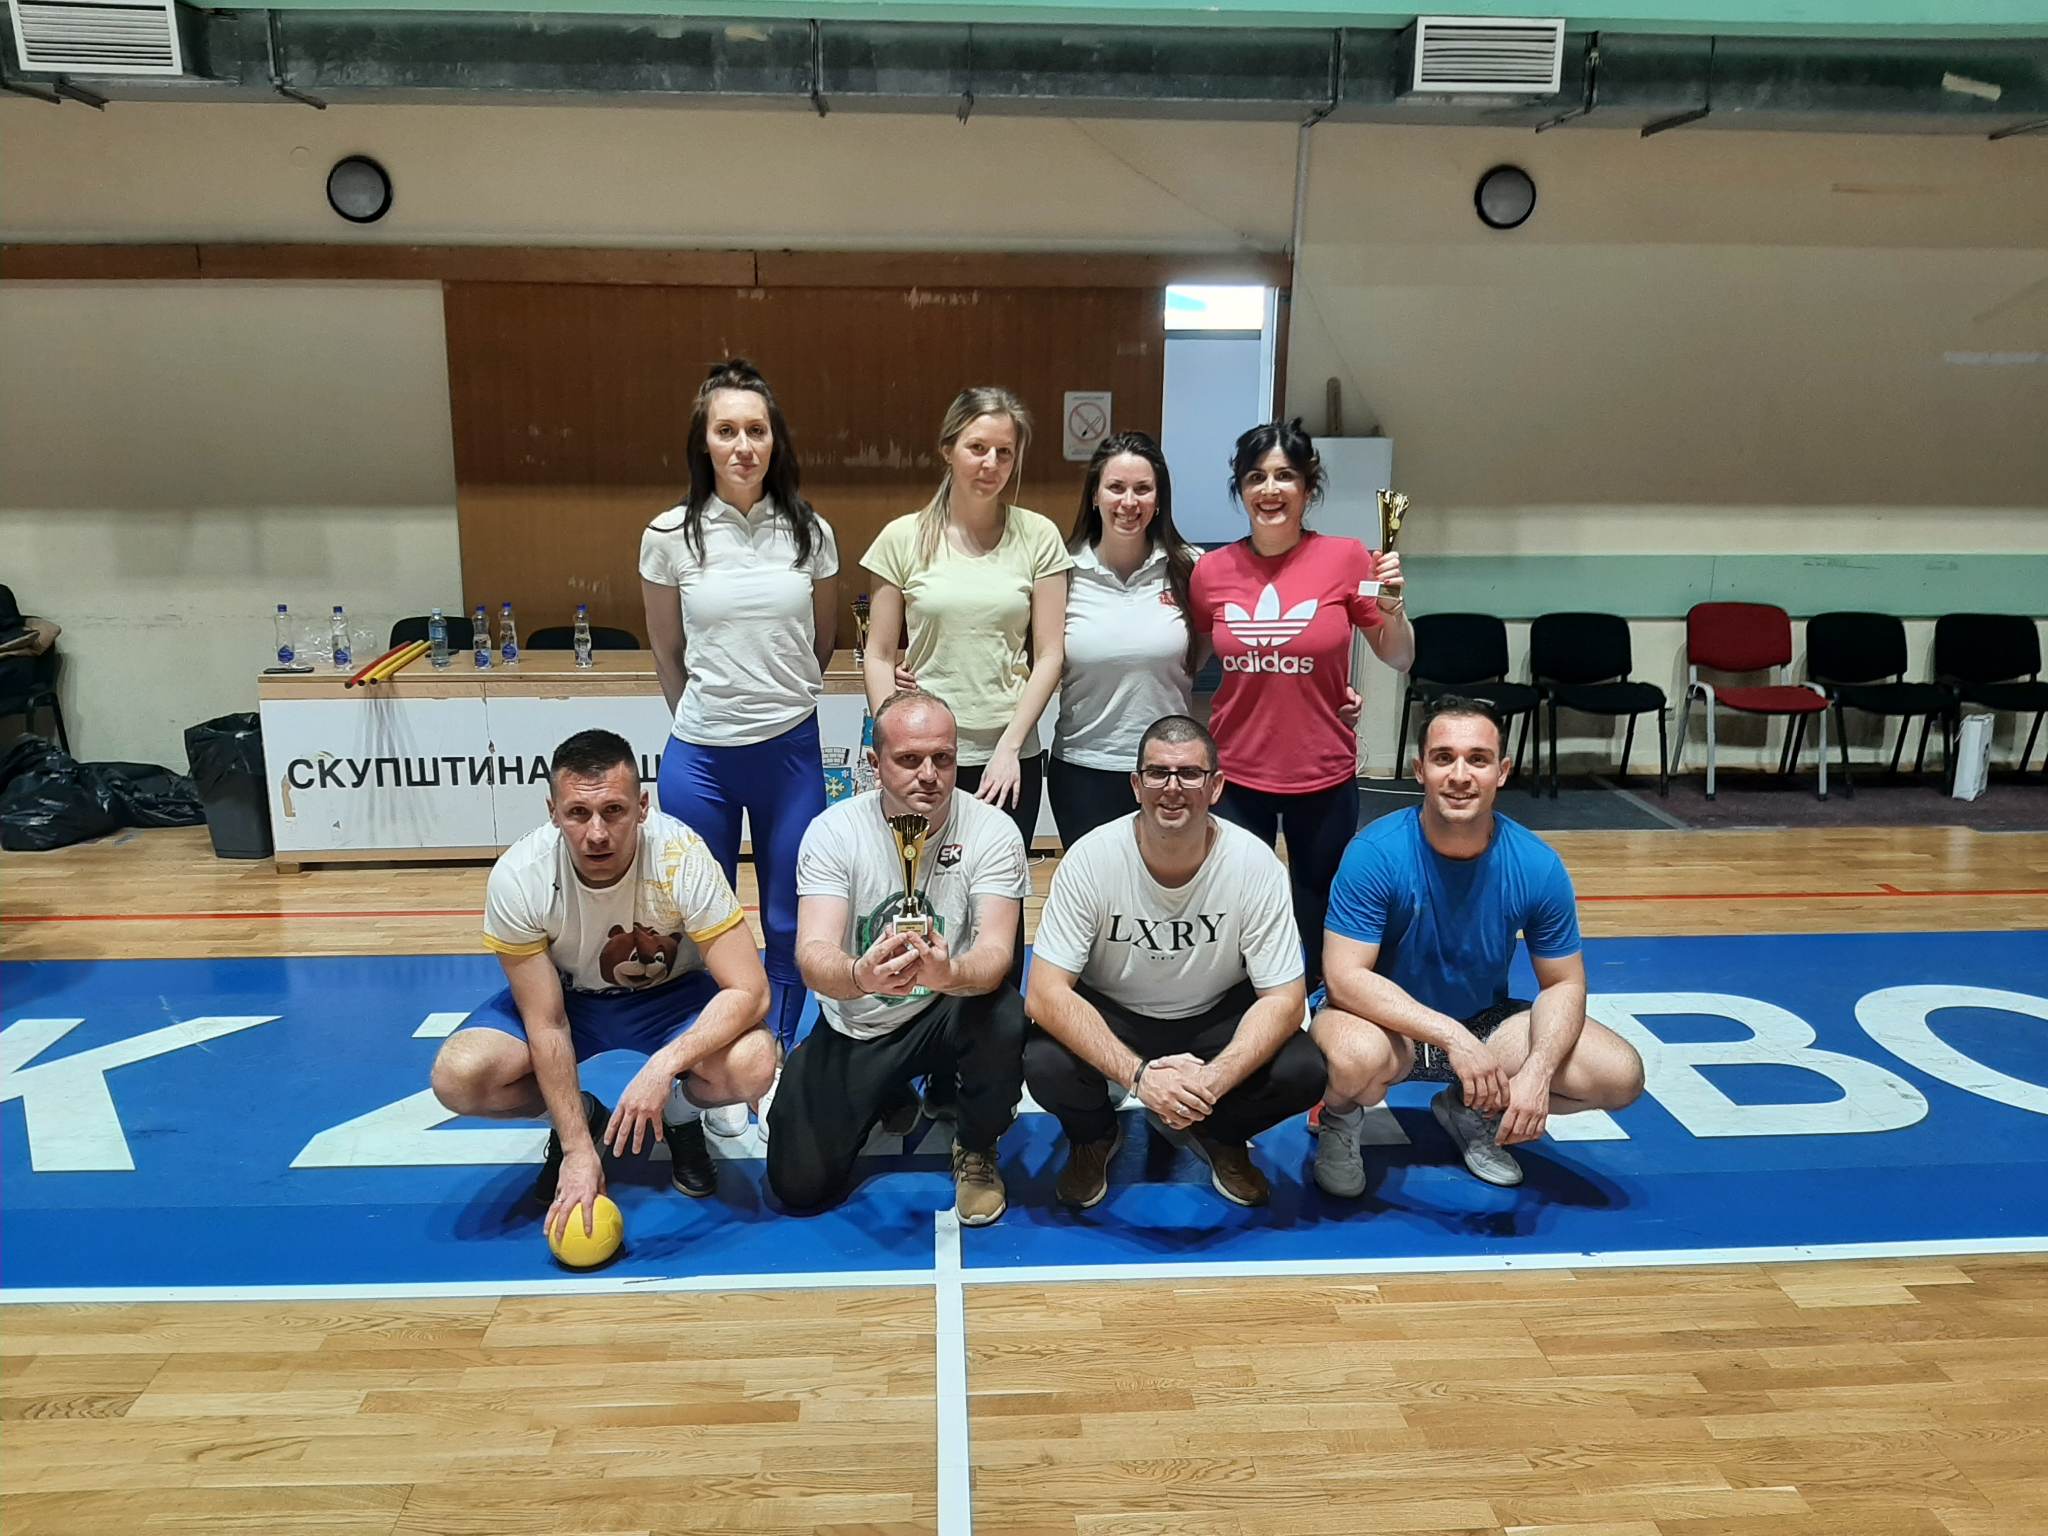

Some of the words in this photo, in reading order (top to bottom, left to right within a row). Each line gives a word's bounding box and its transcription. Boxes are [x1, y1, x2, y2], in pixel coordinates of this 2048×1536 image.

[1222, 650, 1315, 675] adidas
[287, 755, 551, 789] СКУПШТИНА
[1106, 912, 1226, 951] LXRY
